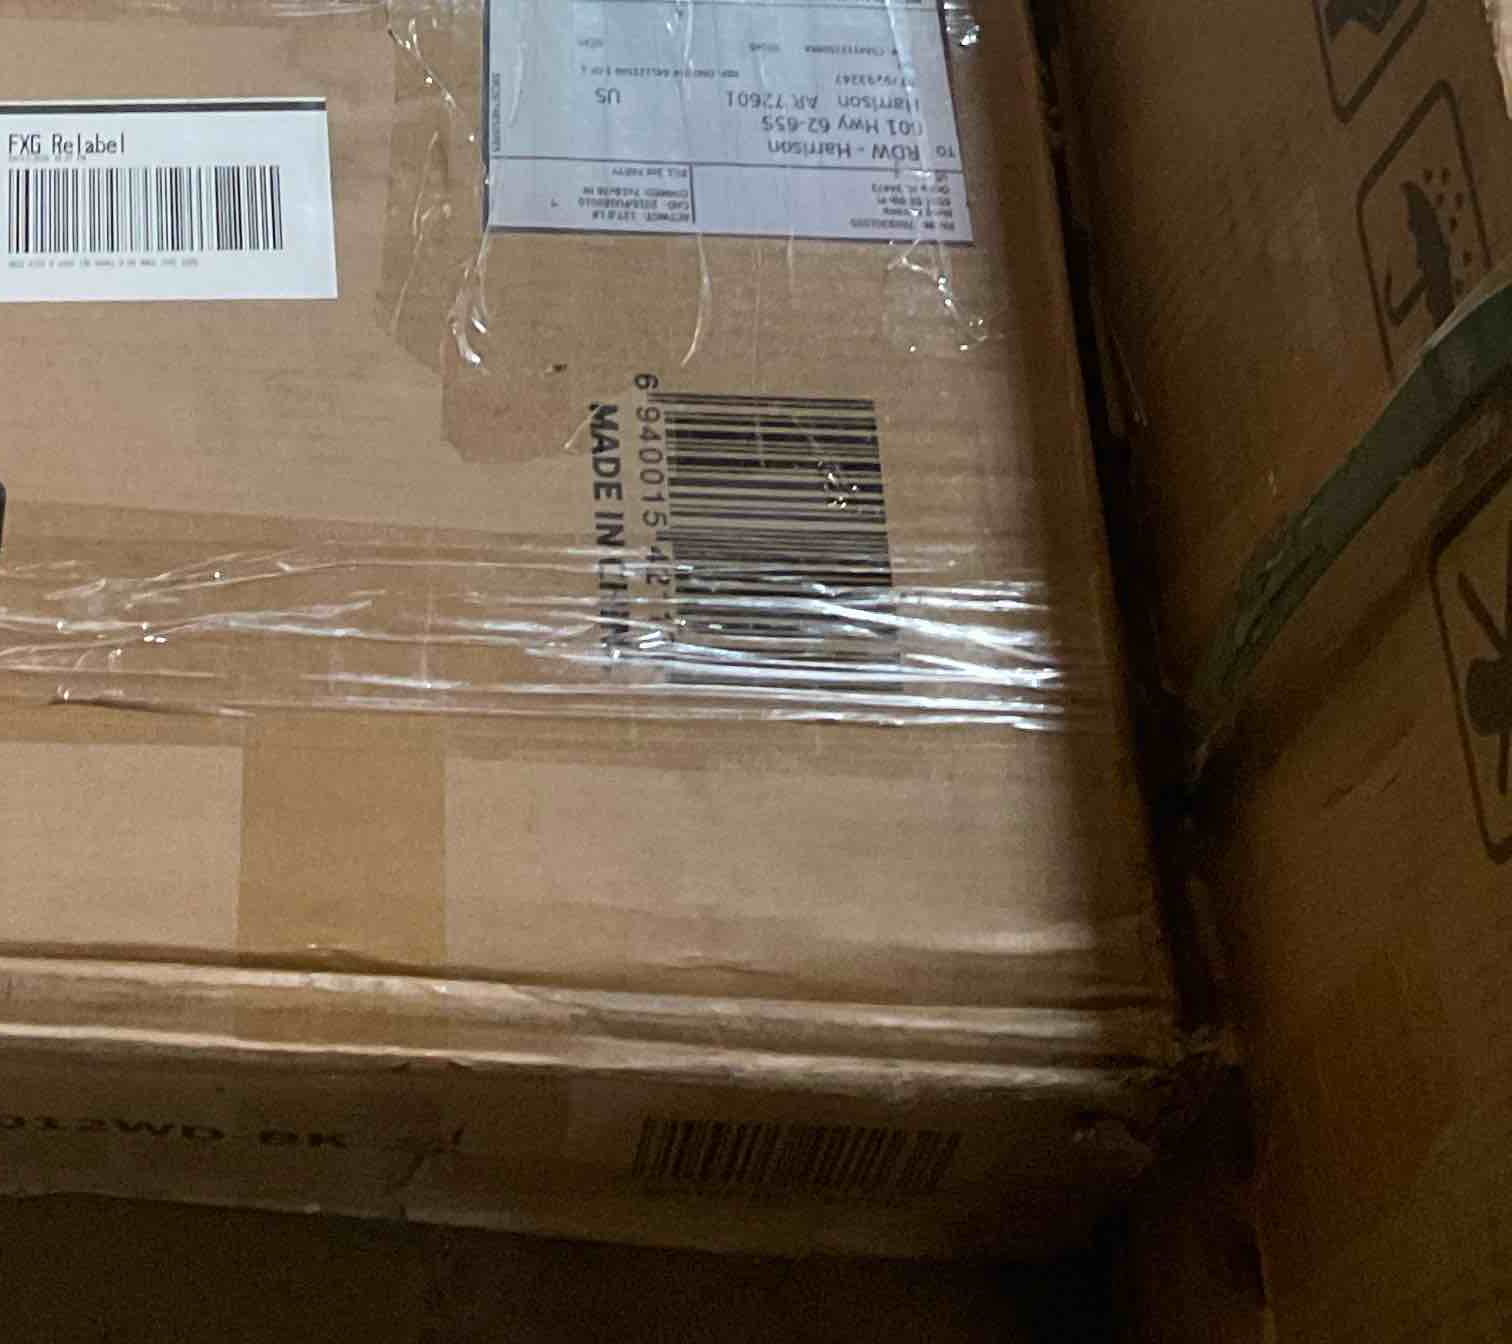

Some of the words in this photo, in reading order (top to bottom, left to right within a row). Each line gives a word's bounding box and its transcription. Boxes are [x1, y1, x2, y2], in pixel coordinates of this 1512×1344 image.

[593, 86, 620, 104] US
[724, 89, 783, 108] 72601
[791, 92, 818, 109] AR
[836, 94, 918, 112] Harrison
[836, 113, 878, 133] Hwy
[7, 133, 42, 156] FXG
[52, 131, 126, 156] Relabel
[766, 139, 850, 158] Harrison
[870, 142, 919, 160] RDW
[587, 401, 621, 501] MADE
[593, 511, 624, 547] IN
